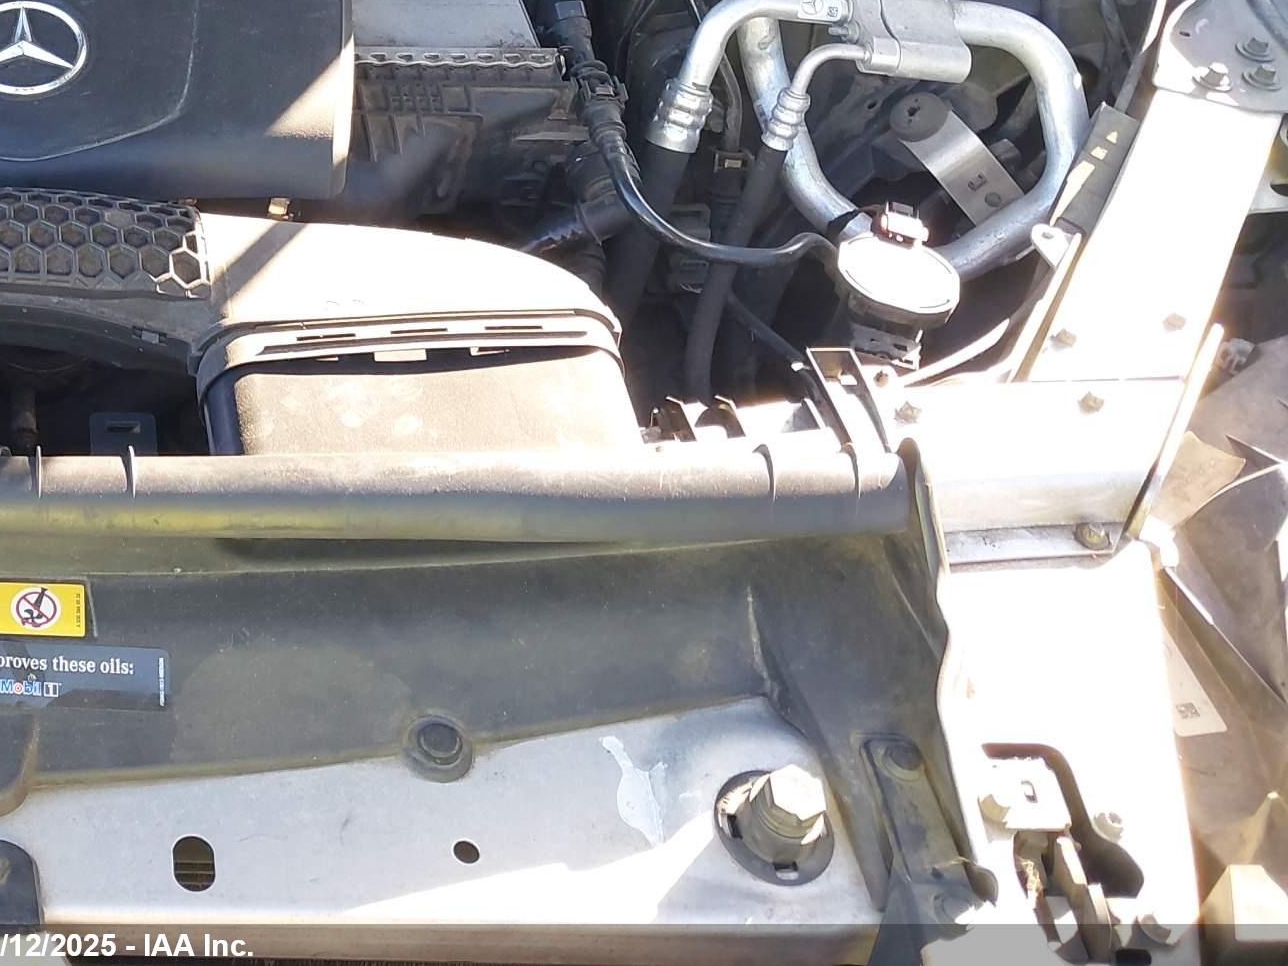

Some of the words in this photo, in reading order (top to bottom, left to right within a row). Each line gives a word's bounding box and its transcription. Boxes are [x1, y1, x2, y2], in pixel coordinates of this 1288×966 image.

[52, 656, 96, 673] these
[100, 658, 134, 675] oils:
[0, 678, 42, 696] Mobil
